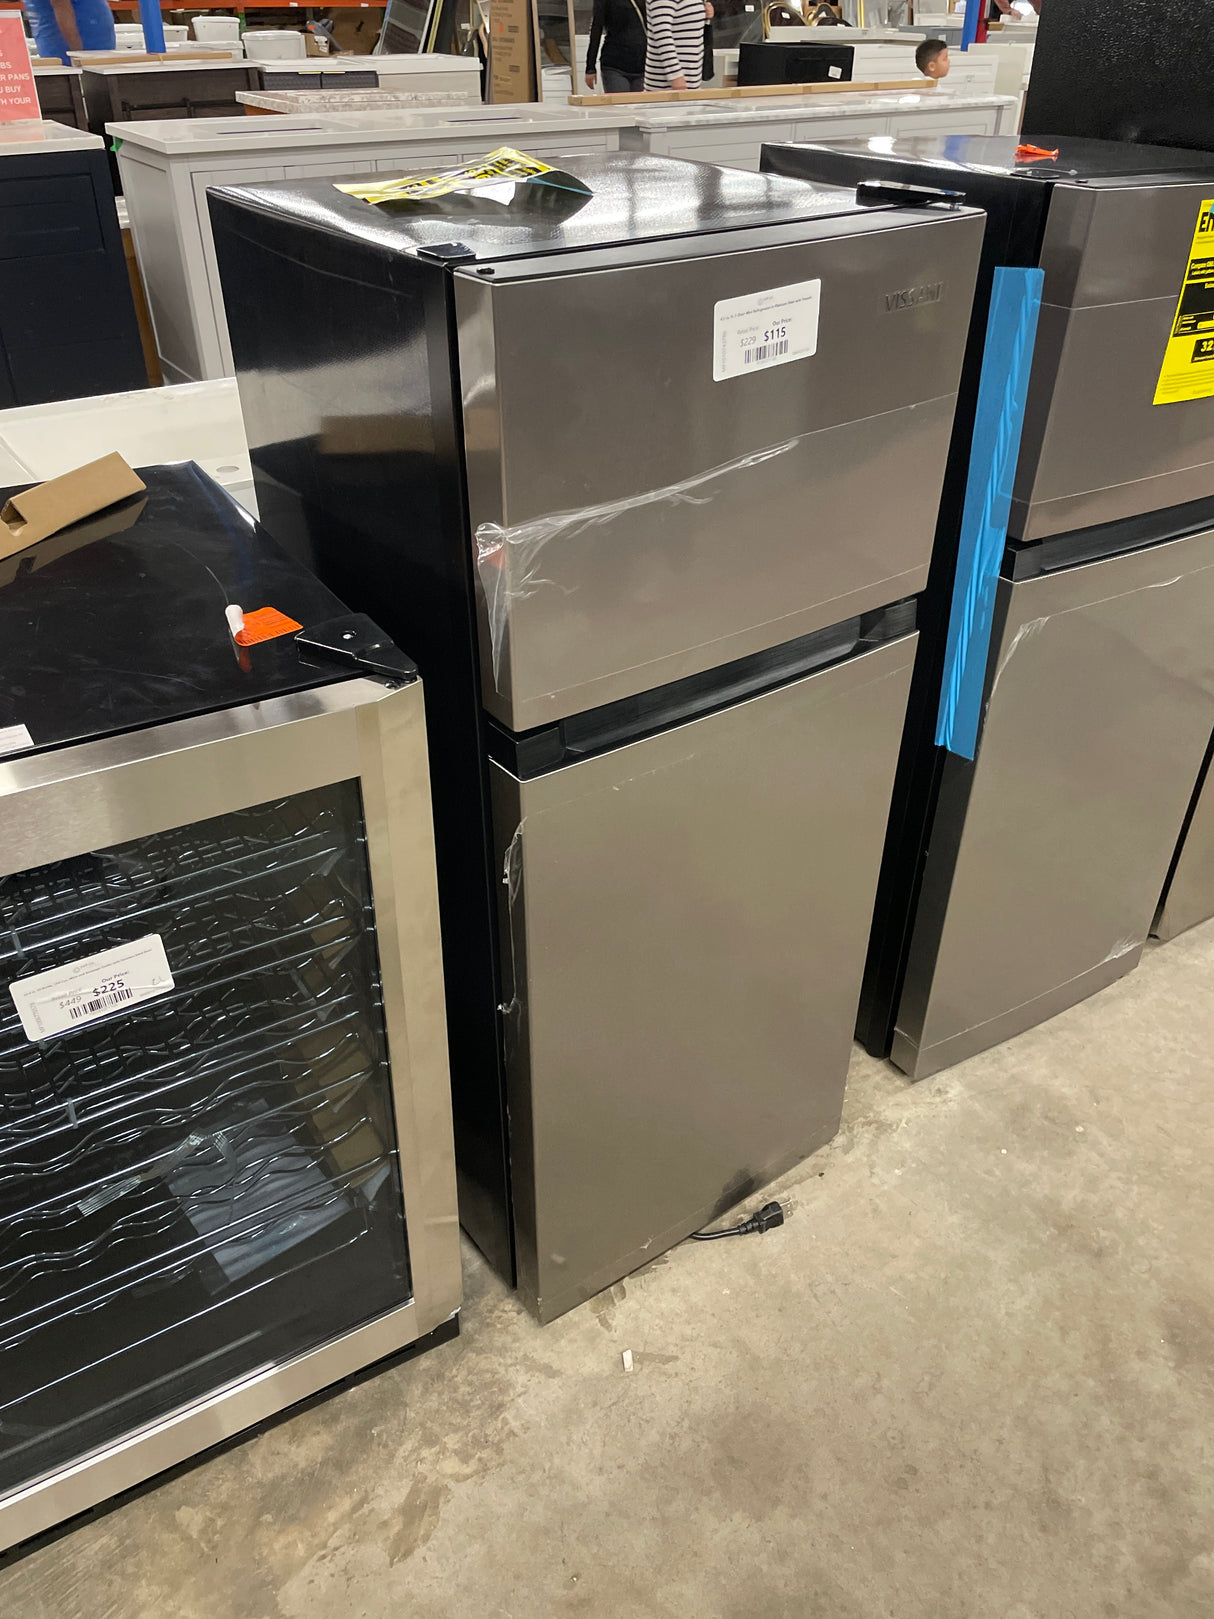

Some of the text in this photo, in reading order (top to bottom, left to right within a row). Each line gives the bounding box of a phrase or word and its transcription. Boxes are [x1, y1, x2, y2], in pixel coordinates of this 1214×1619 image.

[8, 73, 30, 81] PANS
[5, 86, 21, 94] BUY
[9, 97, 31, 105] YOUR
[764, 326, 787, 342] $115
[740, 336, 757, 348] $229
[101, 976, 114, 984] Our
[92, 978, 125, 997] $225
[59, 995, 83, 1010] $449
